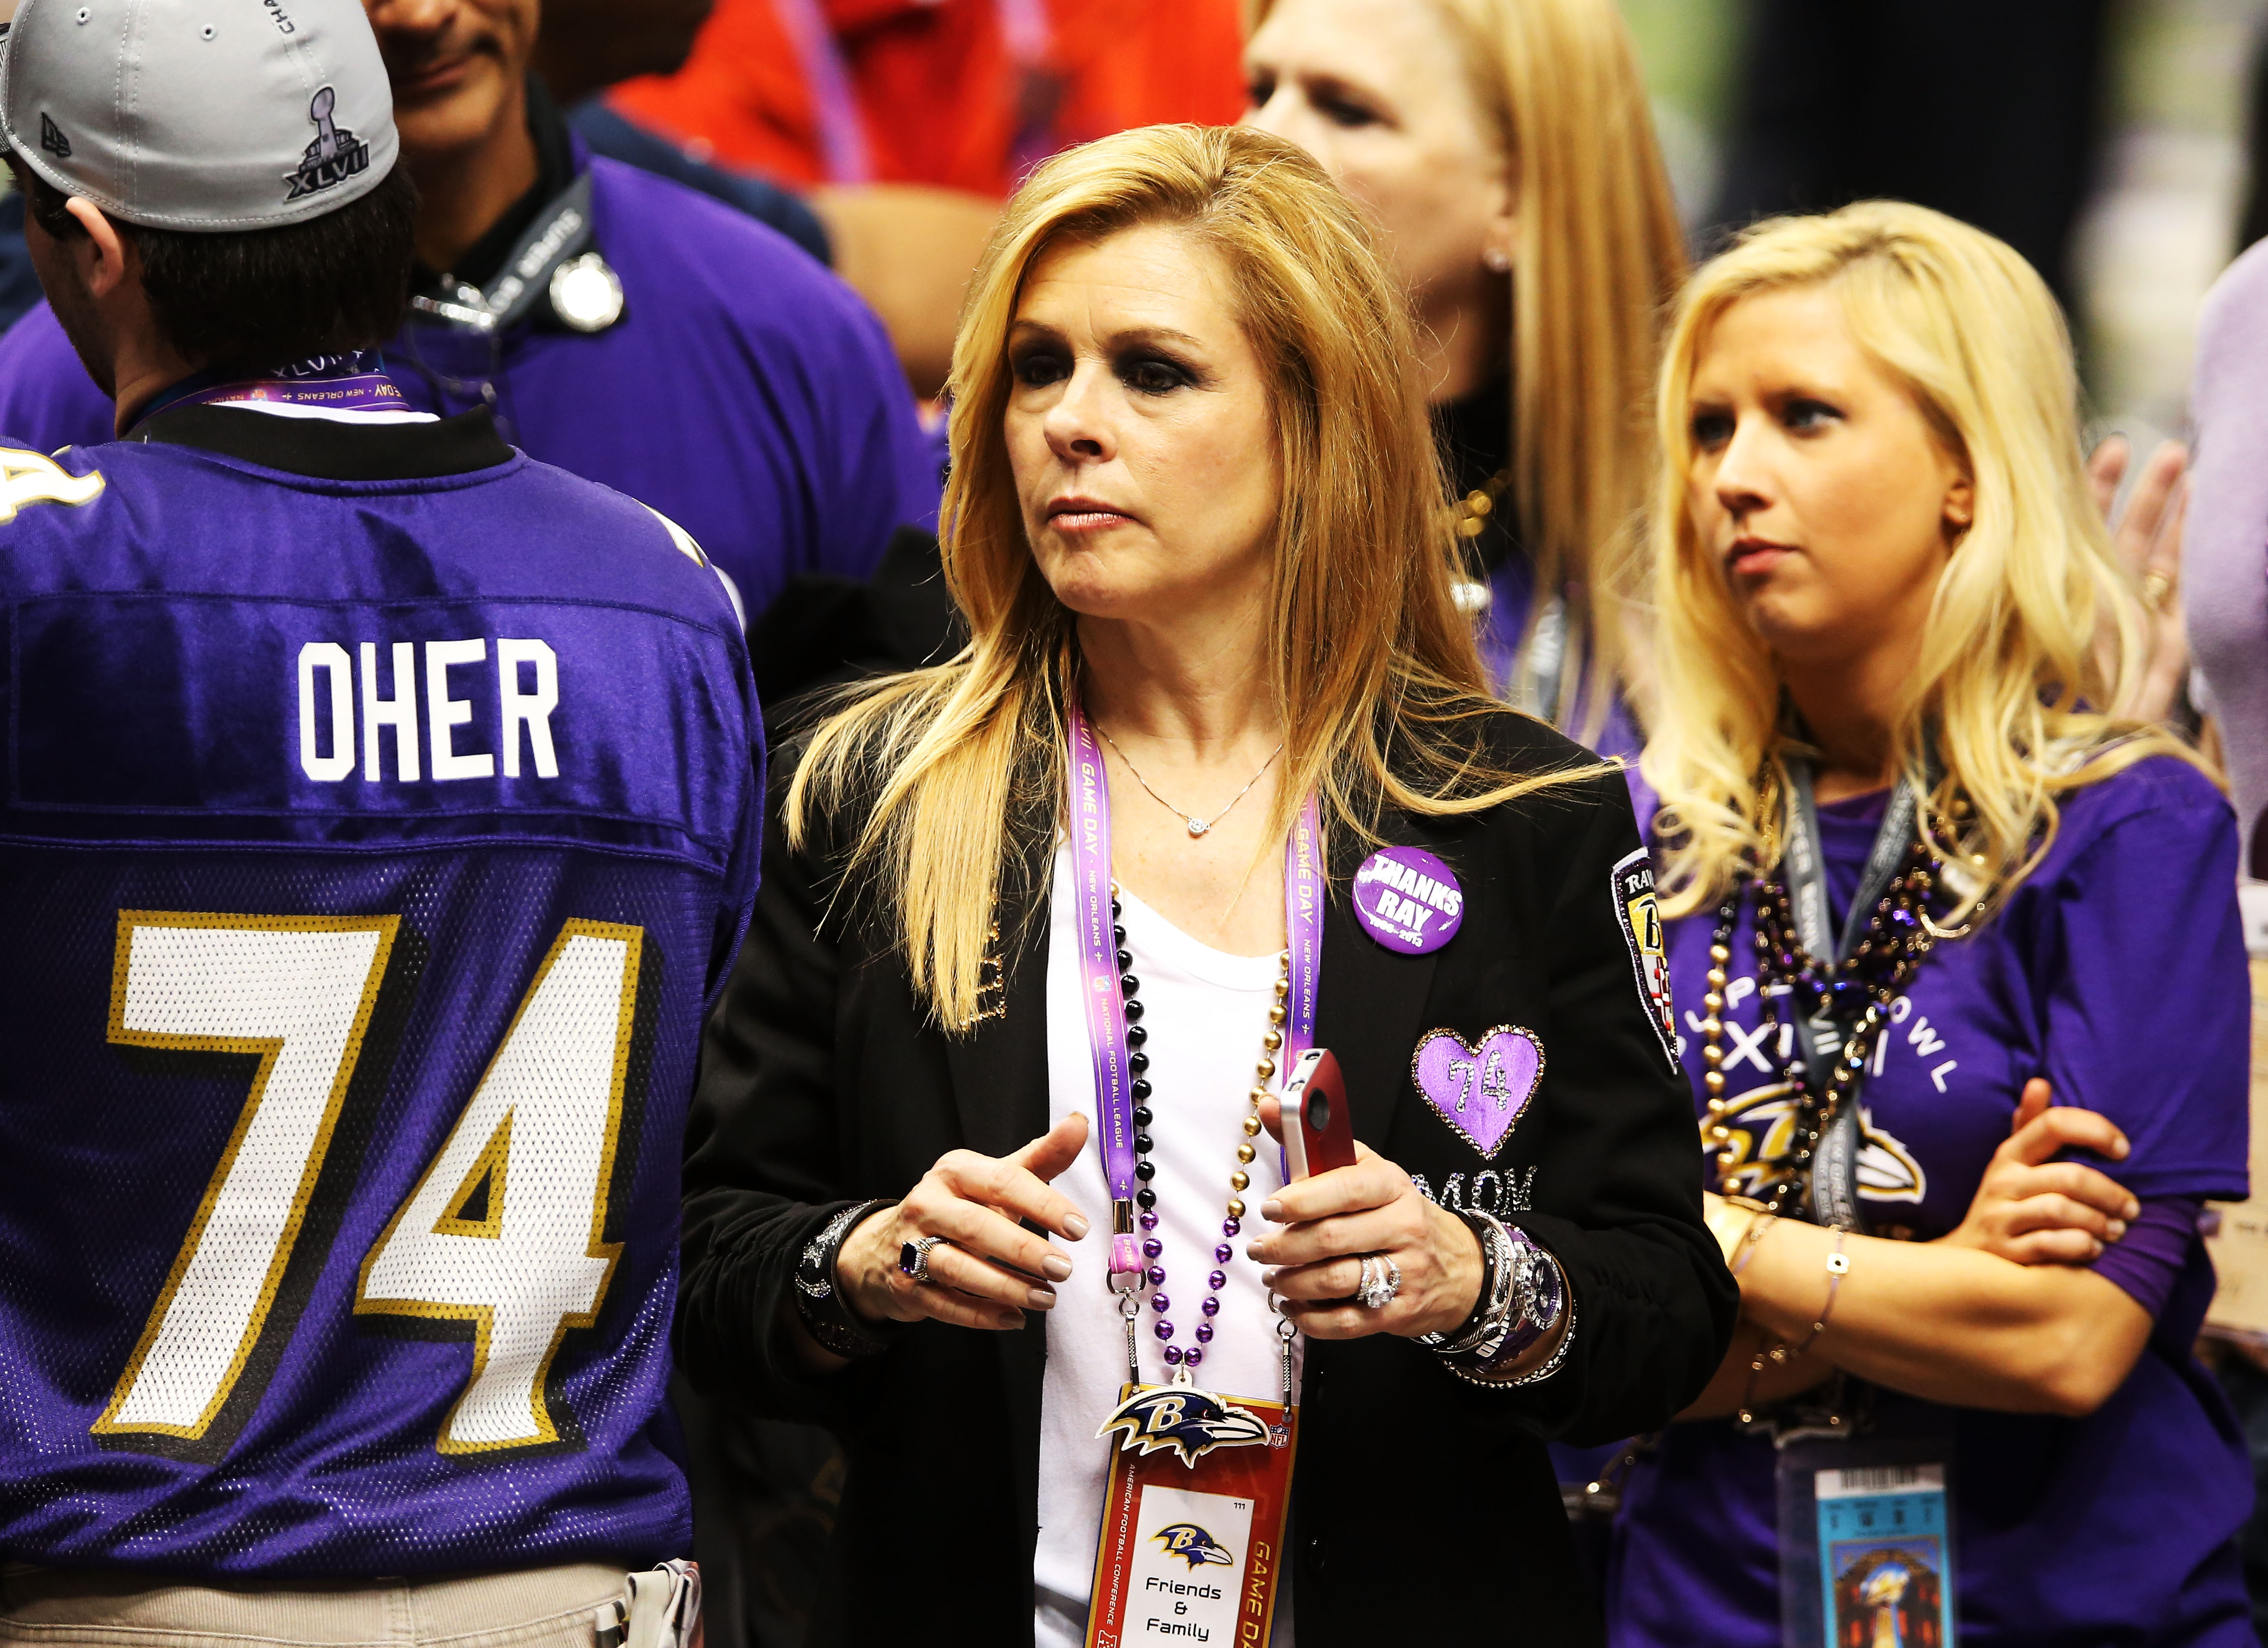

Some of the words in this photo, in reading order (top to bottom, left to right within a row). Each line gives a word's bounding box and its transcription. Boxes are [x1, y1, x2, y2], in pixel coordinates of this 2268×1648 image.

[286, 143, 369, 198] XLVII
[297, 390, 343, 400] ORLEANS
[346, 388, 364, 397] NEW
[298, 637, 559, 782] OHER
[1081, 762, 1097, 815] GAME
[1083, 818, 1099, 856] DAY
[1297, 828, 1312, 880] GAME
[1088, 869, 1097, 894] NEW
[1298, 885, 1313, 924] DAY
[1374, 853, 1463, 916] THANKS
[1089, 895, 1101, 947] ORLEANS
[1375, 889, 1434, 933] RAY
[1303, 966, 1311, 1019] ORLEANS
[1101, 998, 1114, 1048] NATIONAL
[1108, 1050, 1119, 1105] FOOTBALL
[1449, 1050, 1511, 1113] 74
[1113, 1107, 1124, 1149] LEAGUE
[91, 909, 644, 1456] 74
[1411, 1165, 1537, 1215] MOM
[1123, 1239, 1134, 1269] BOWL
[1270, 1434, 1286, 1445] NFL
[1123, 1463, 1135, 1512] AMERICAN
[1115, 1513, 1128, 1561] FOOTBALL
[1107, 1564, 1121, 1626] CONFERENCE
[1146, 1577, 1221, 1600] Friends
[1245, 1541, 1270, 1617] GAME
[1147, 1618, 1209, 1642] Family
[1174, 1602, 1188, 1615] &
